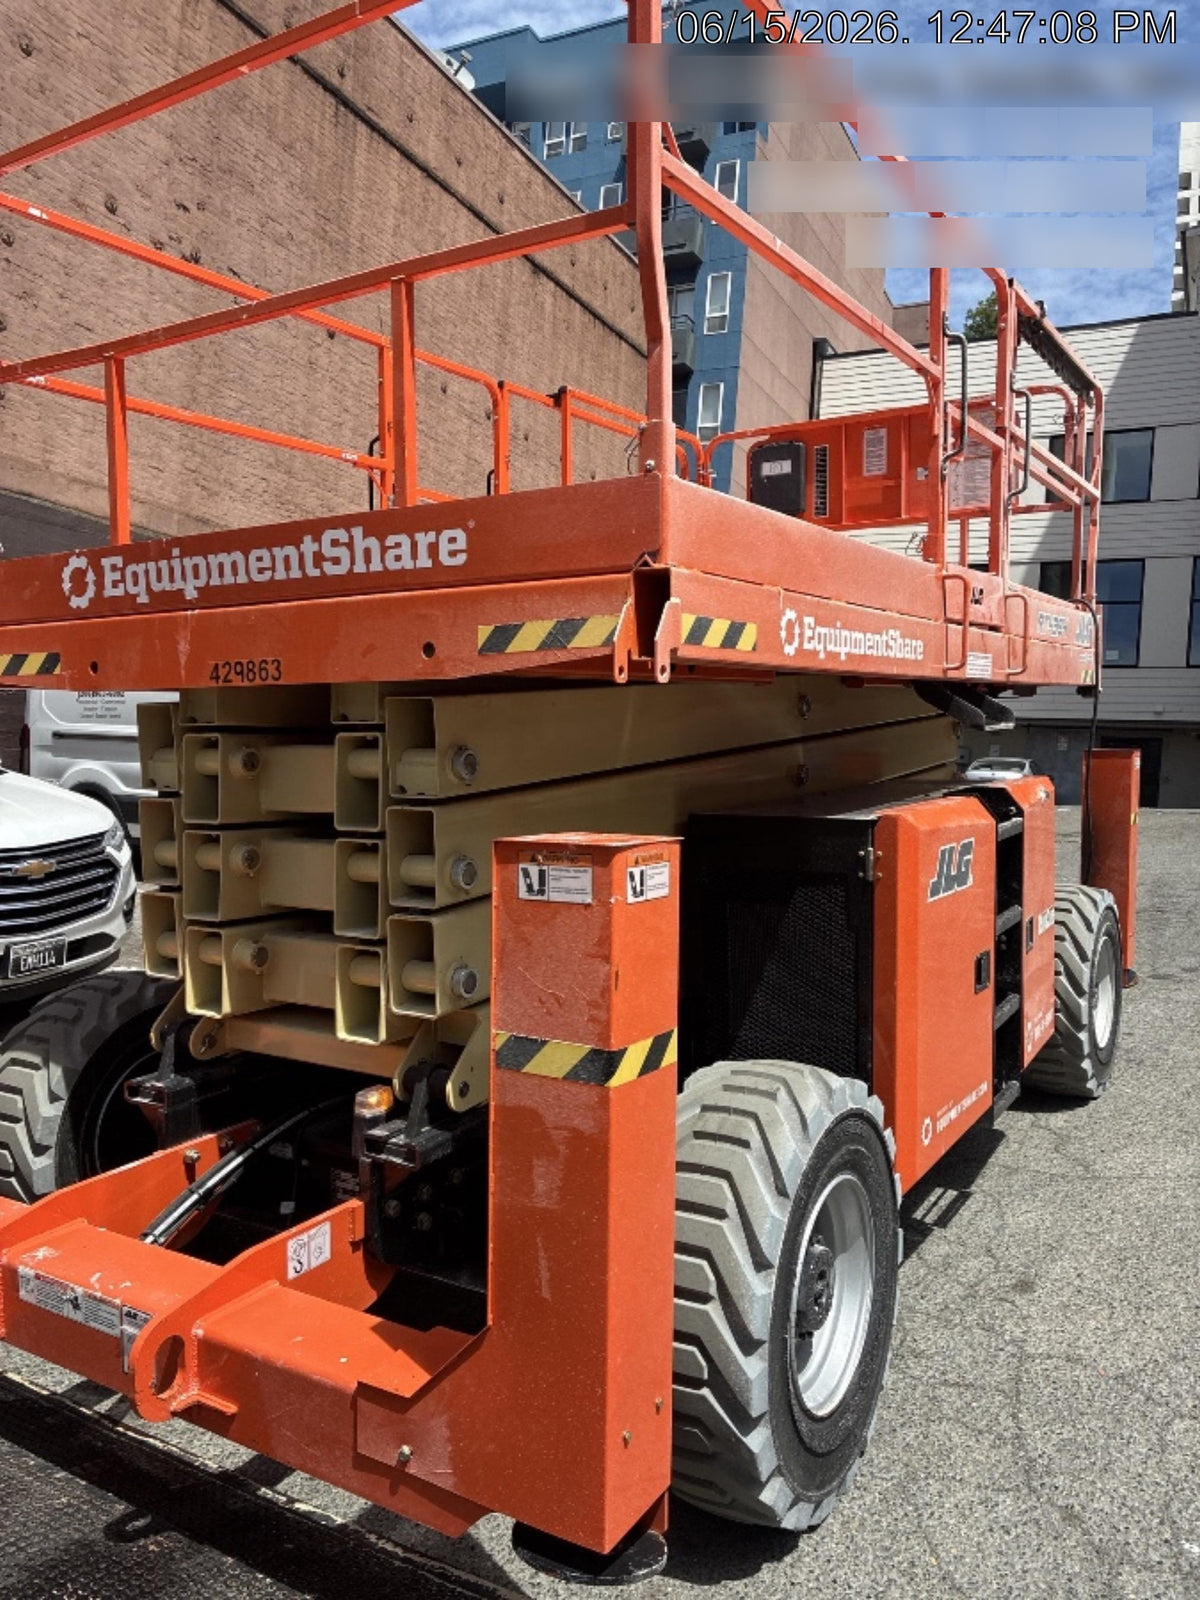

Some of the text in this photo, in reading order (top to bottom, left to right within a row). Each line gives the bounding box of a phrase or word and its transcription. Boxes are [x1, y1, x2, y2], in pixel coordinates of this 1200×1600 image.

[101, 525, 468, 604] EquipmentShare
[802, 615, 924, 661] EquipmentShare
[209, 659, 282, 684] 429863
[928, 837, 975, 902] JLG
